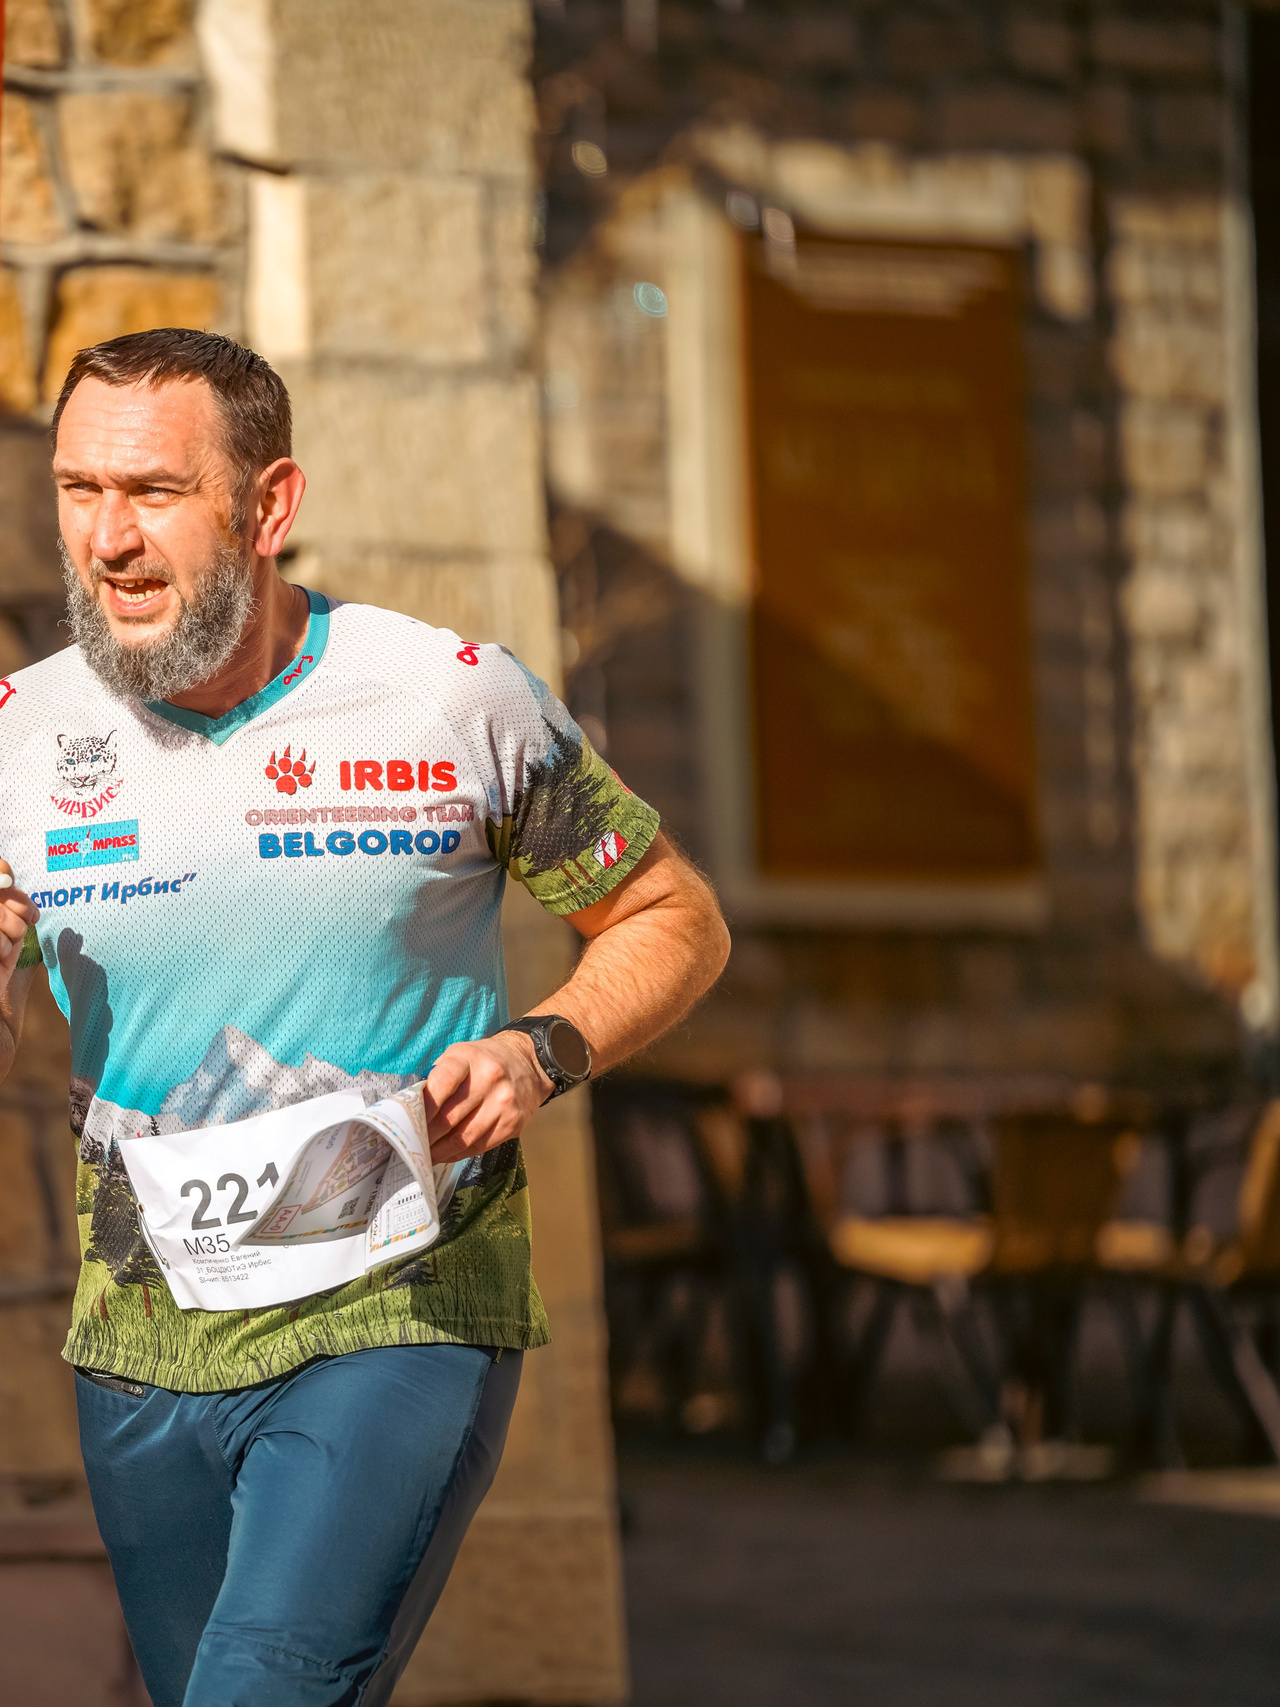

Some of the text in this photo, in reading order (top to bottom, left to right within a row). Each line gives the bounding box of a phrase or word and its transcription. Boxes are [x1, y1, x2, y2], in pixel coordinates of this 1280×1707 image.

[339, 759, 458, 792] IRBIS
[244, 803, 475, 827] ORIENTEERING TEAM
[258, 828, 462, 860] BELGOROD
